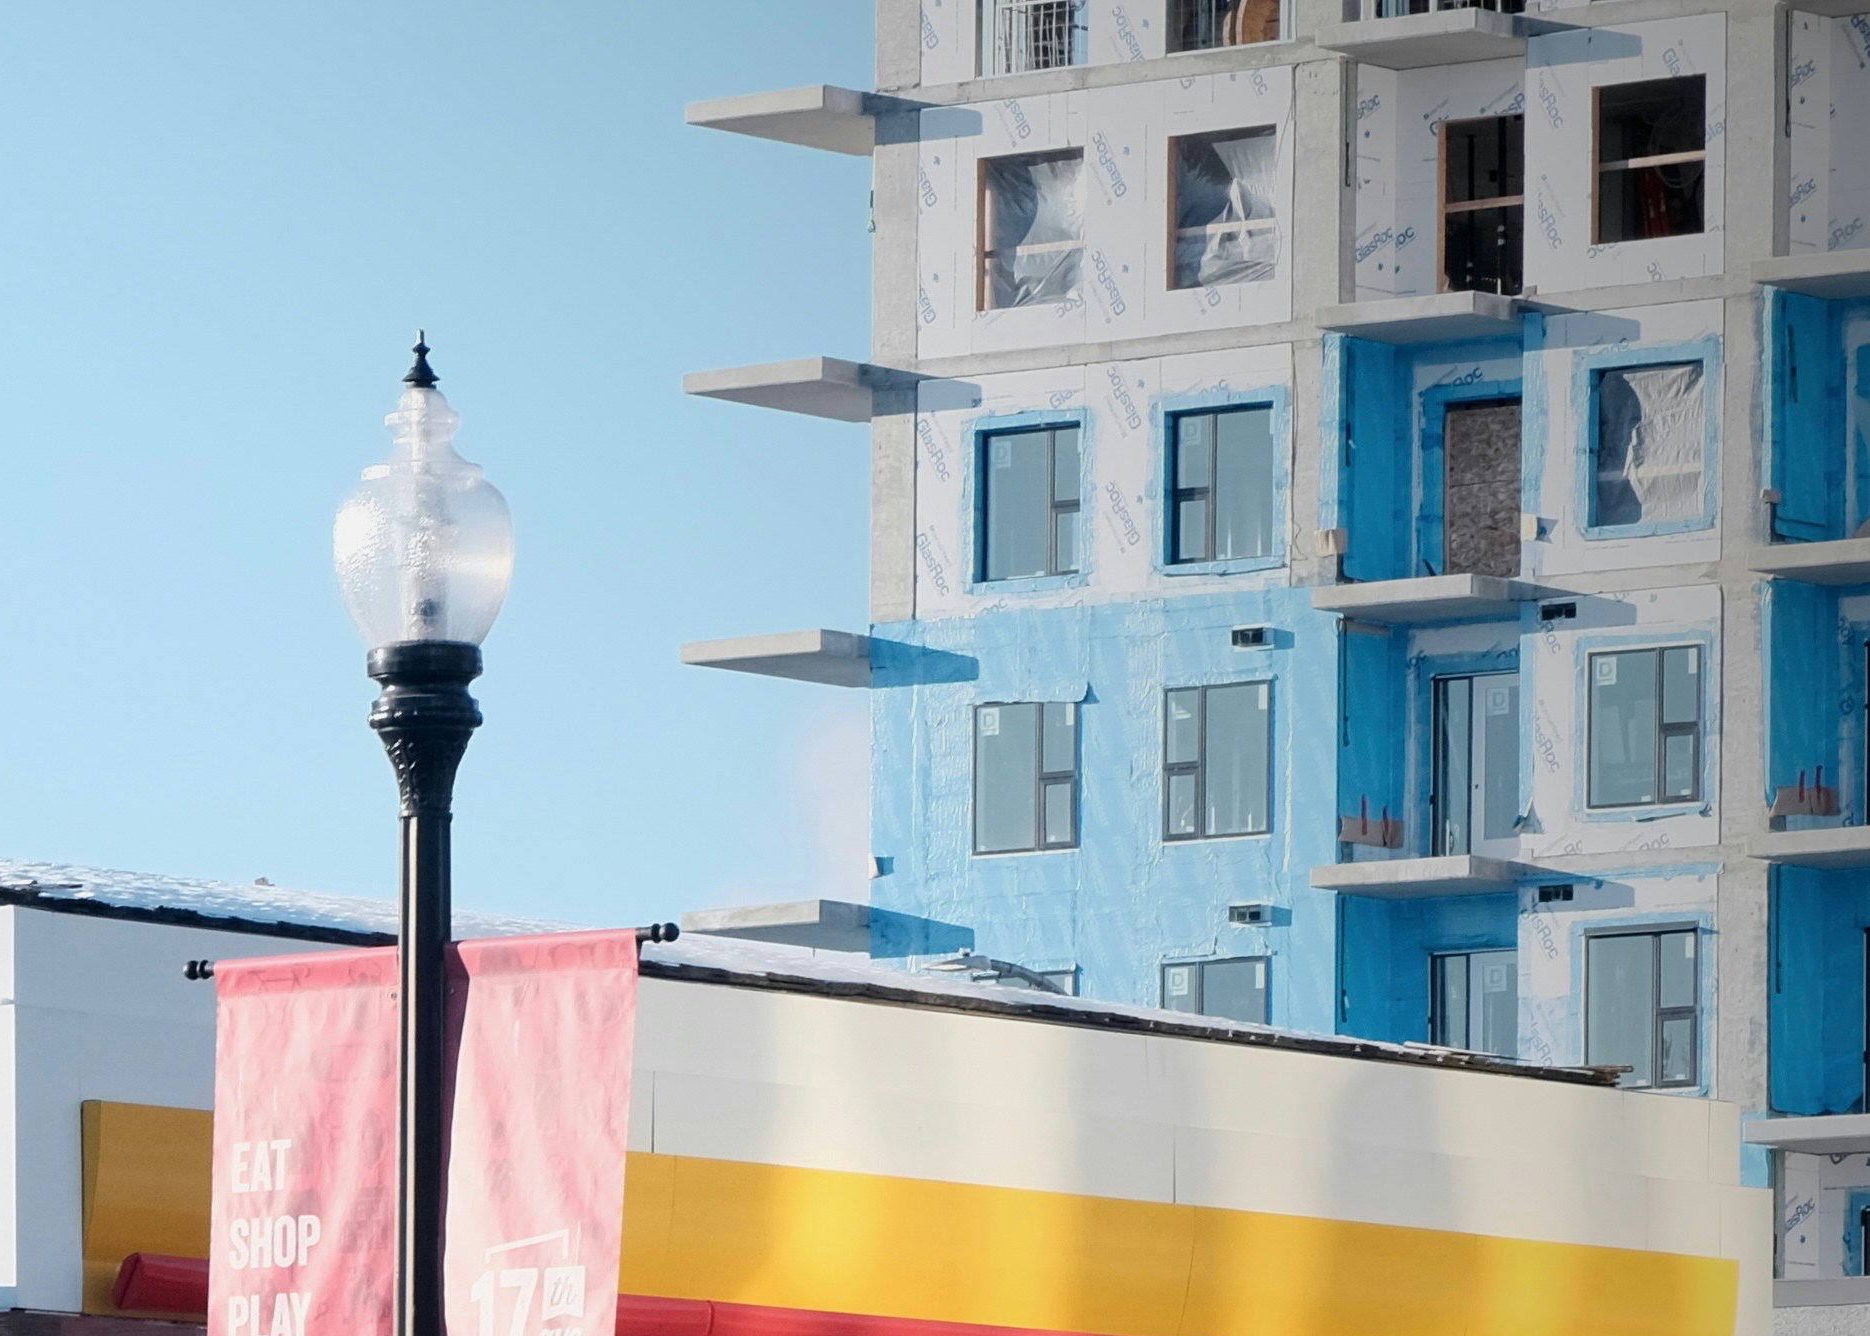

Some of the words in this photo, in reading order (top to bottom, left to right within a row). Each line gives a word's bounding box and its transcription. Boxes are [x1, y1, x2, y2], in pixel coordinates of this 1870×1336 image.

[1092, 131, 1127, 198] GlasRoc
[1091, 250, 1126, 316] GlasRoc
[231, 1139, 291, 1193] EAT
[228, 1215, 320, 1270] SHOP
